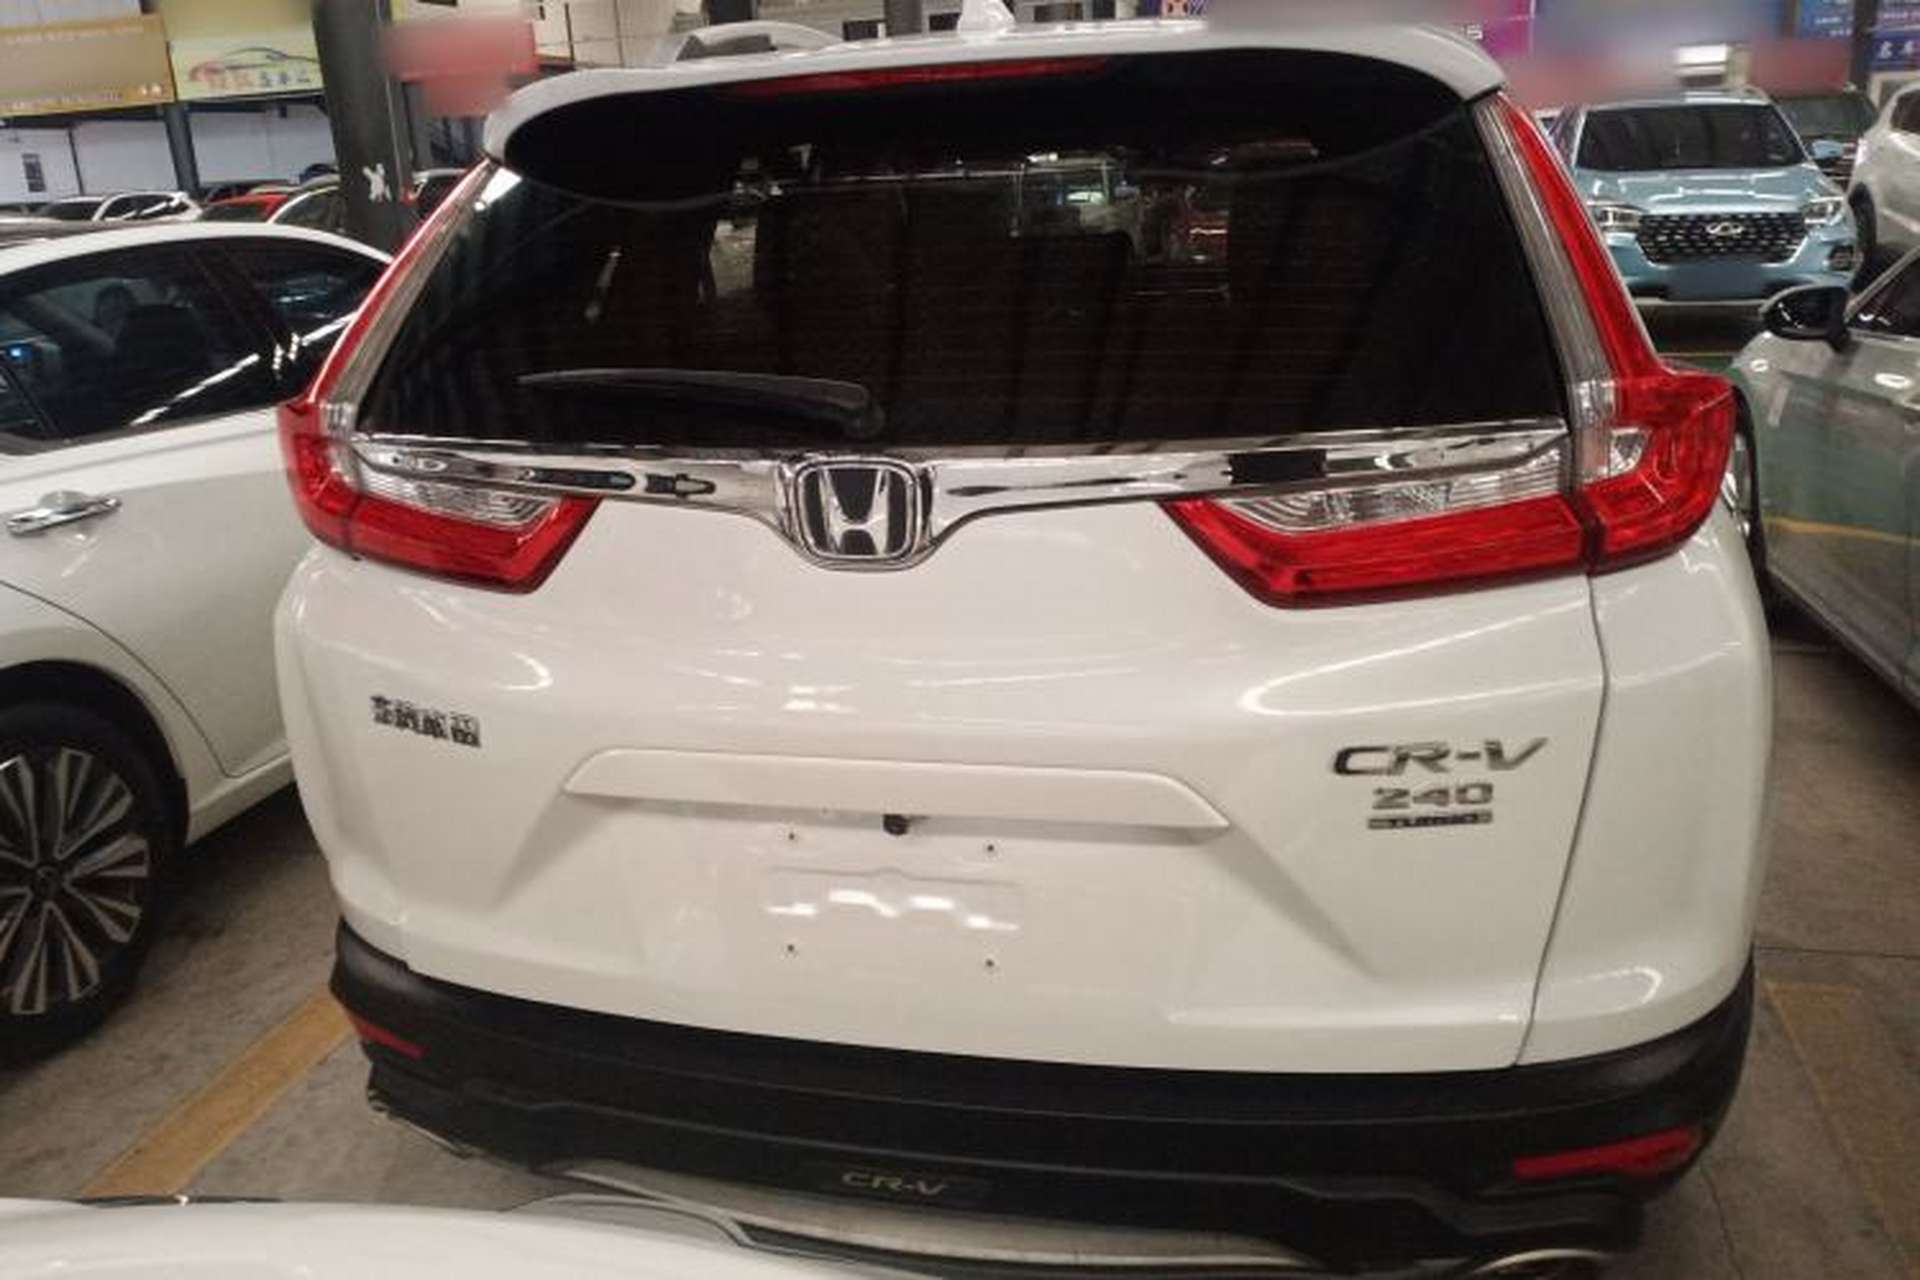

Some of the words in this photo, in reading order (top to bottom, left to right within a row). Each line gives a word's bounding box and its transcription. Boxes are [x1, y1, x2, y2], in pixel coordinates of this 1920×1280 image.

[1333, 737, 1548, 776] CR-V
[1371, 783, 1493, 810] 240
[842, 1172, 949, 1196] CR-V
